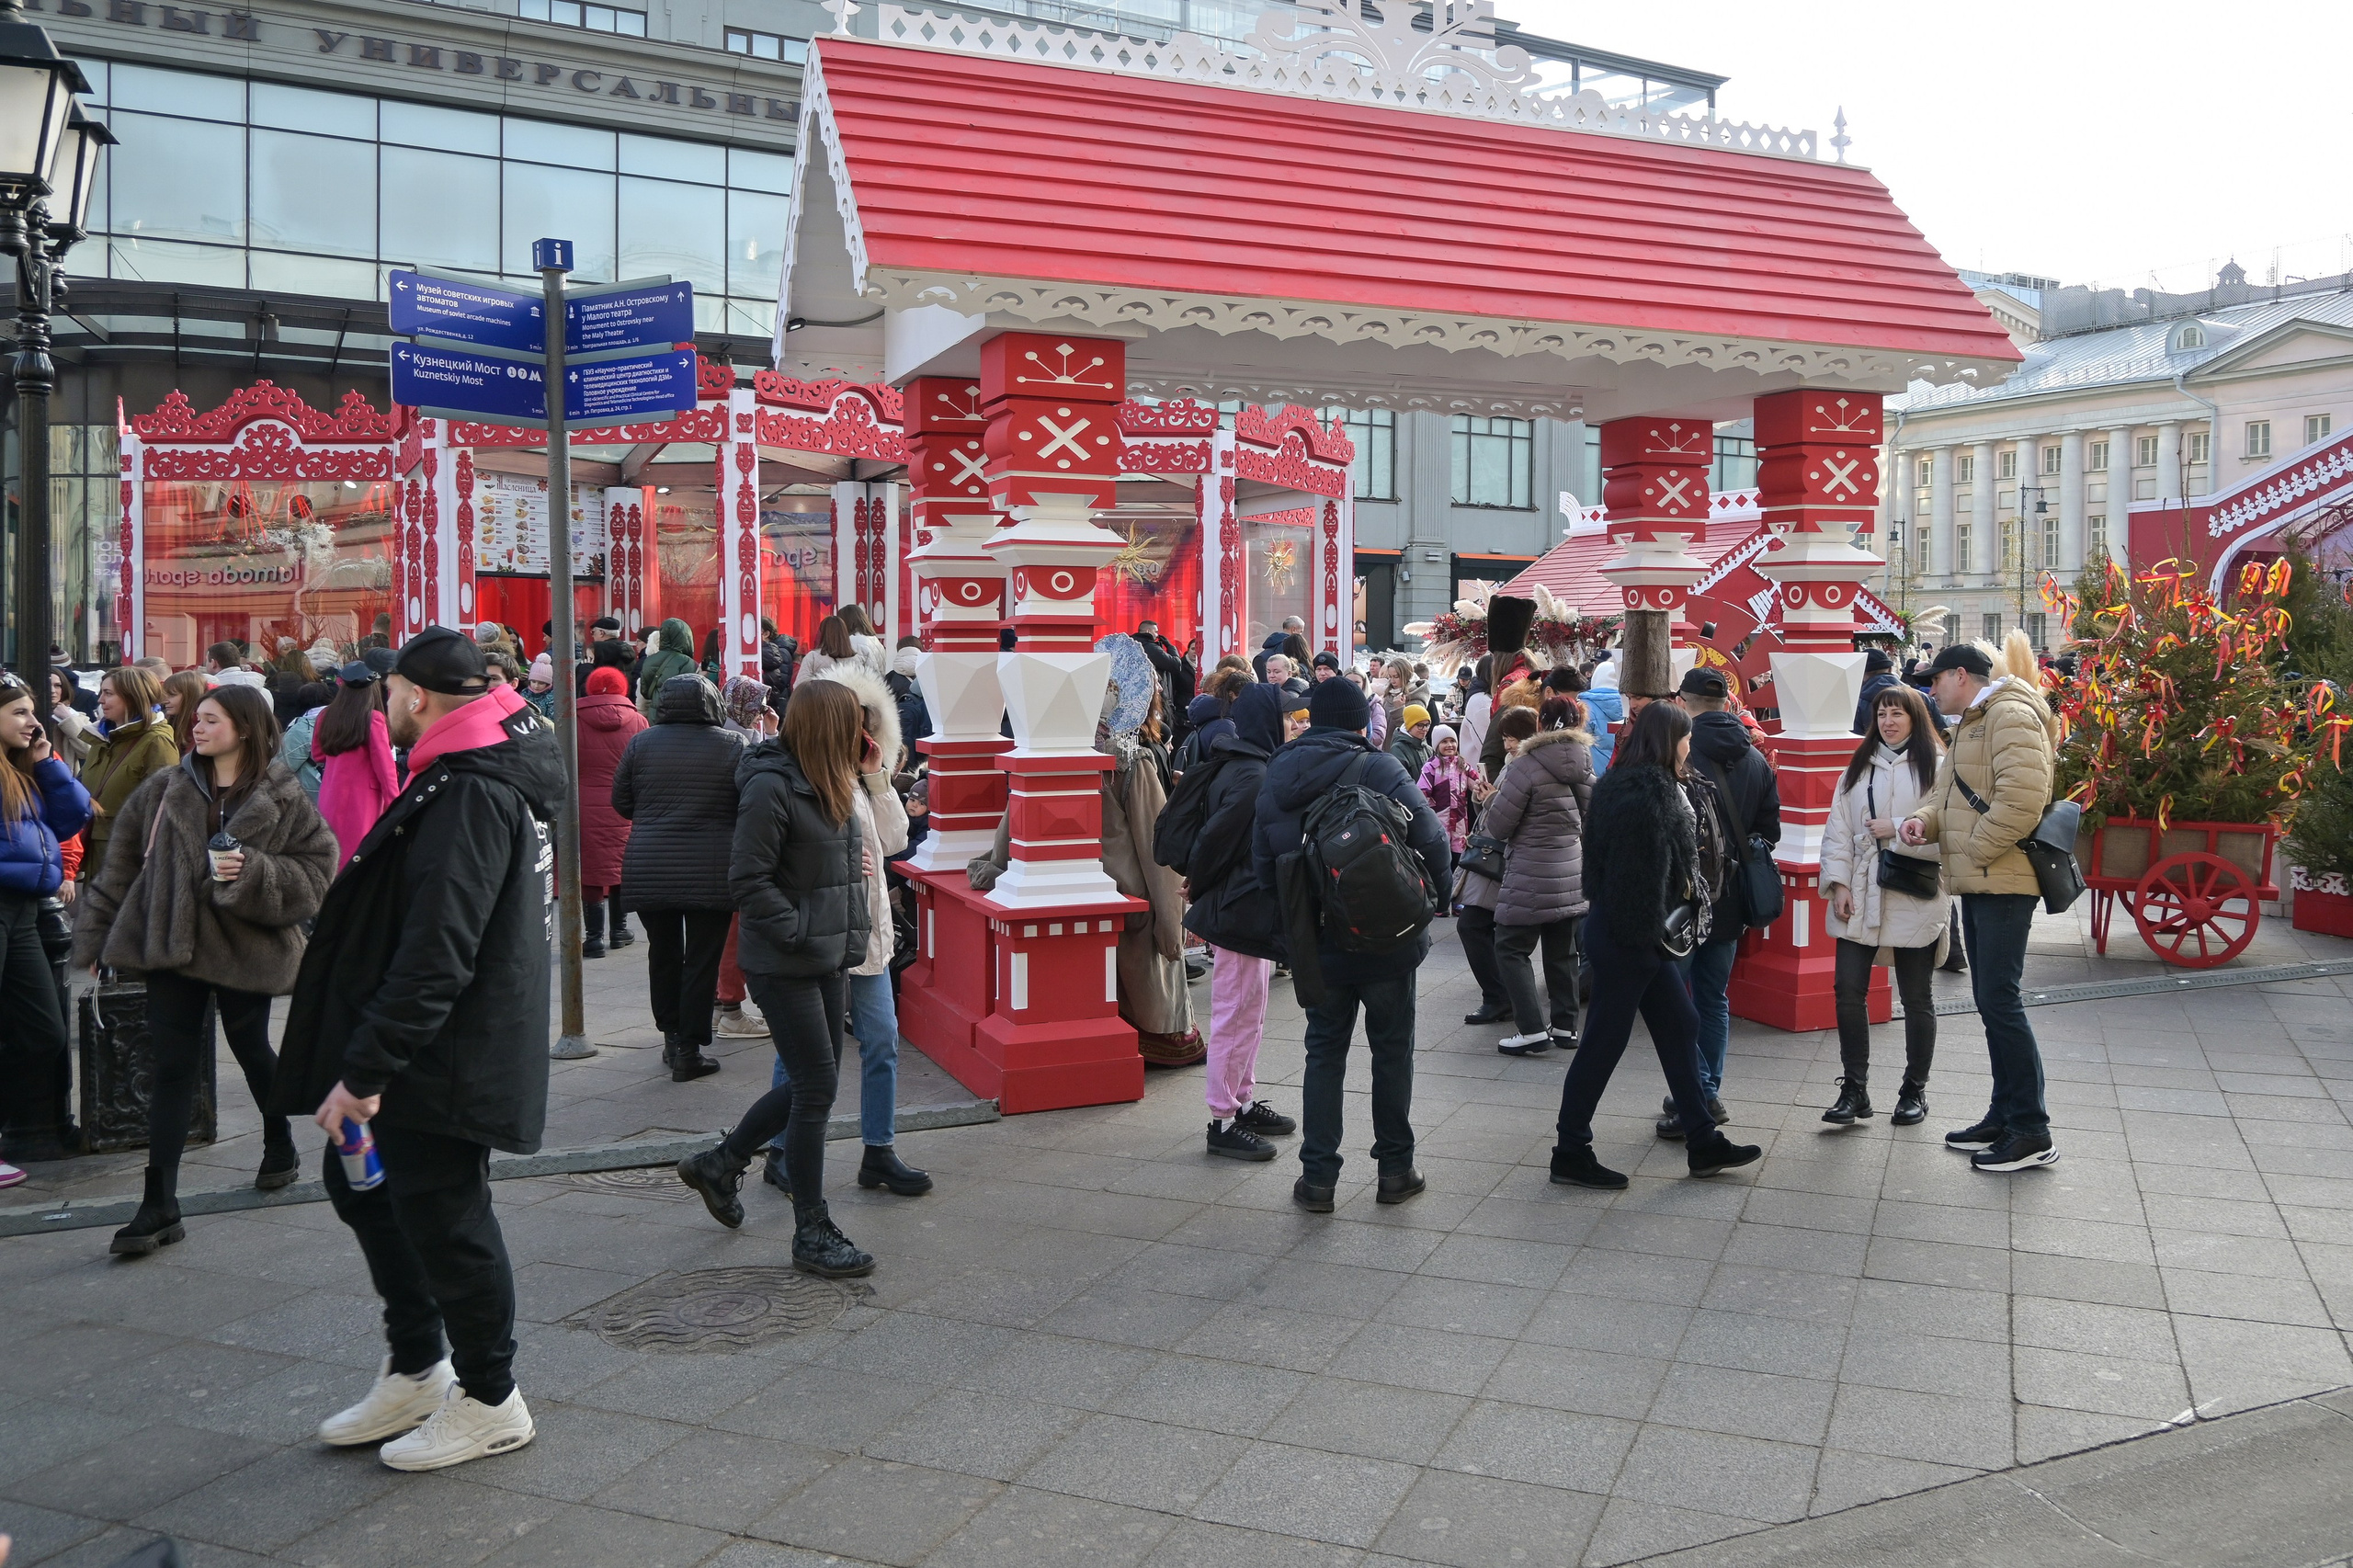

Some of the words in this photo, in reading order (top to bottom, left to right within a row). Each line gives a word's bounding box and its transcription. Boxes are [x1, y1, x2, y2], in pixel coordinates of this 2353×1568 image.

[313, 28, 801, 121] УНИВЕРСАЛЬНЫ
[416, 284, 441, 295] Музей
[443, 290, 482, 302] советских
[483, 296, 515, 309] игровых
[416, 294, 459, 308] автоматов
[582, 302, 614, 312] Памятник
[626, 295, 669, 307] Островскому
[416, 304, 442, 314] Museum
[442, 307, 449, 315] of
[449, 310, 466, 319] soviet
[467, 312, 485, 323] arcade
[485, 317, 512, 326] machines
[610, 309, 632, 319] театра
[583, 322, 609, 330] Monument
[617, 317, 642, 327] Ostrovsky
[592, 331, 604, 340] Maly
[605, 329, 624, 337] Theater
[414, 353, 472, 372] Кузнецкий
[474, 361, 501, 376] Мост
[414, 369, 460, 385] Kuznetskiy
[462, 375, 483, 386] Most
[616, 371, 632, 381] центр
[632, 368, 665, 378] диагностики
[628, 375, 657, 385] технологий
